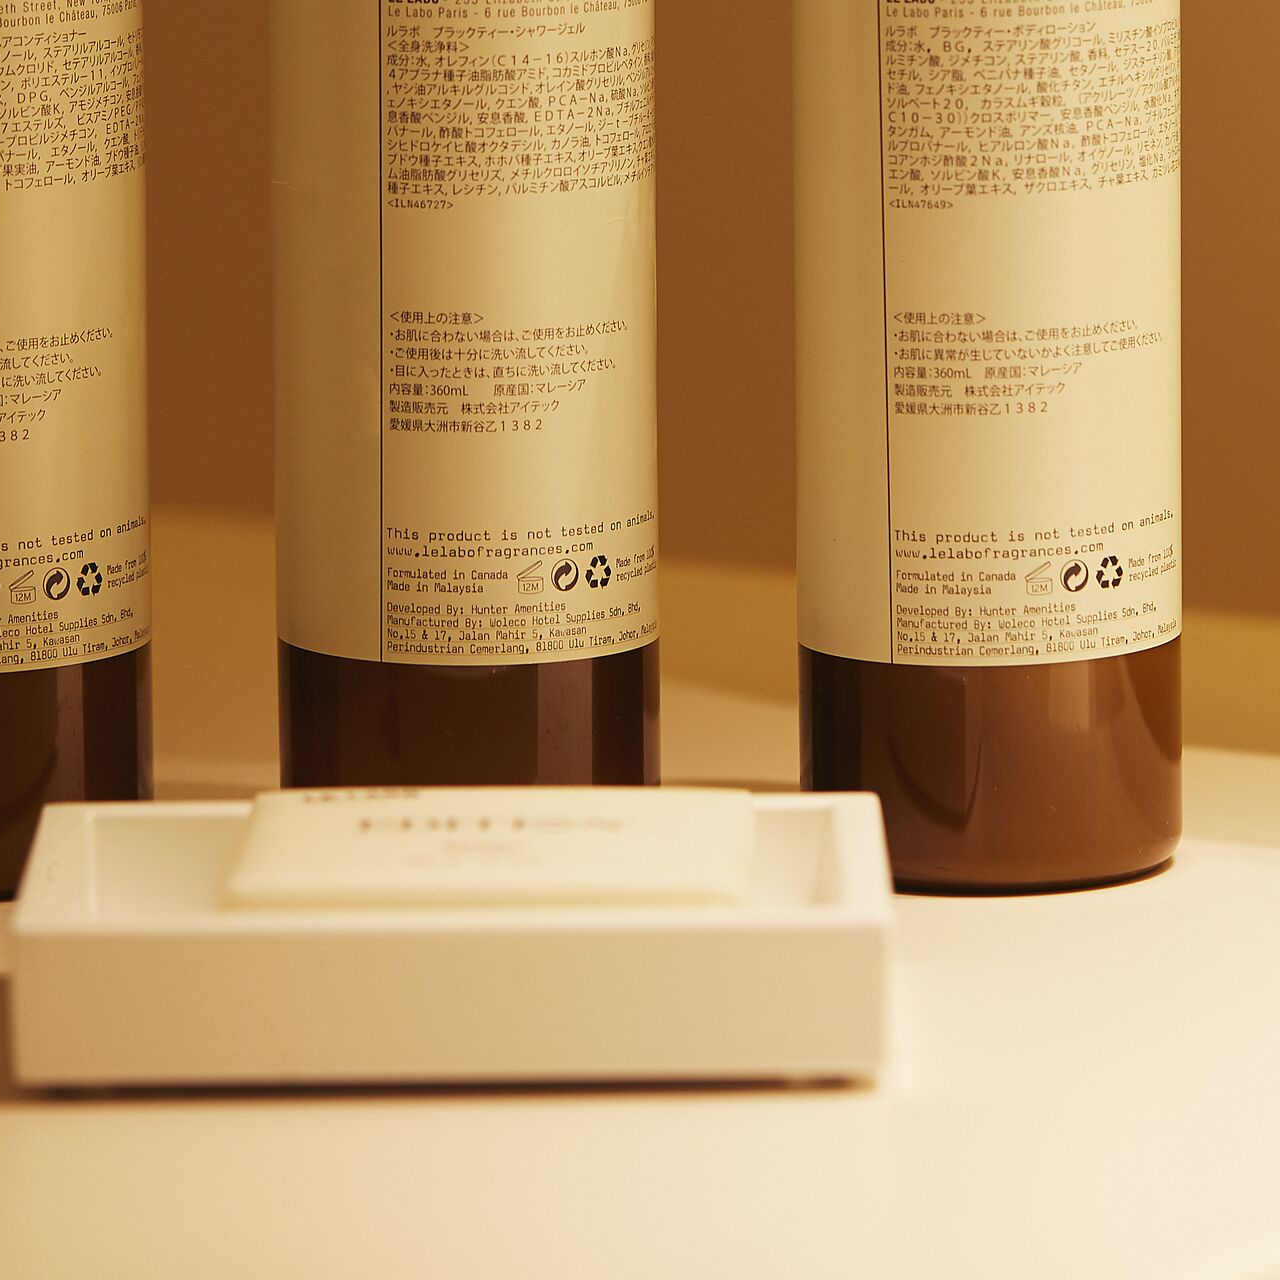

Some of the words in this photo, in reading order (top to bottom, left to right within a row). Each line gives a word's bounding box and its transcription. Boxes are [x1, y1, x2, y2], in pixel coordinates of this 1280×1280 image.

[894, 383, 953, 398] 製造販売元
[964, 381, 1065, 398] 株式会社アイテック
[389, 399, 449, 416] 製造販売元
[460, 399, 559, 415] 株式会社アイテック
[18, 537, 44, 551] not
[51, 529, 93, 547] tested
[100, 528, 112, 538] on
[386, 527, 419, 541] This
[429, 530, 492, 545] product
[501, 529, 518, 542] is
[527, 528, 552, 540] not
[561, 521, 604, 537] tested
[610, 521, 621, 531] on
[894, 529, 926, 542] This
[936, 531, 998, 545] product
[1008, 530, 1025, 543] is
[1035, 528, 1060, 541] not
[1069, 522, 1114, 538] tested
[1121, 521, 1134, 531] on
[387, 540, 593, 558] www.lelabofragrances.com
[895, 542, 1104, 560] www.lelabofragrances.com
